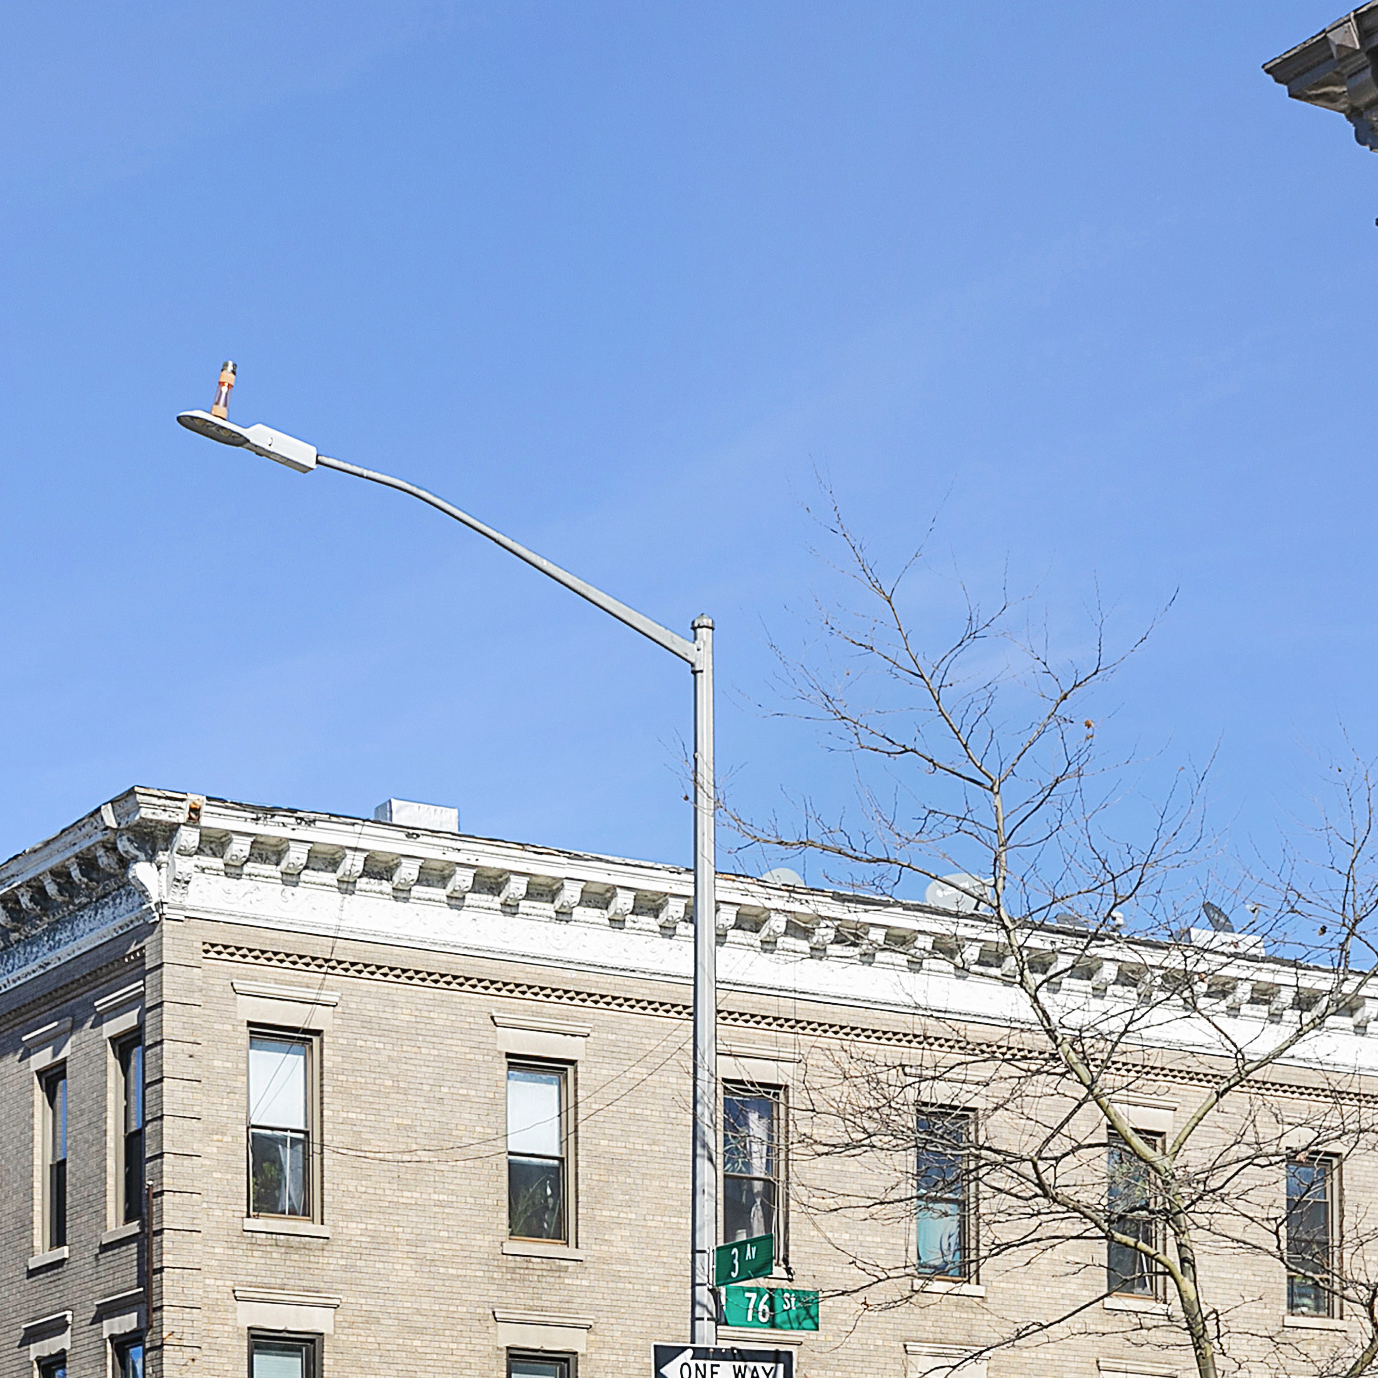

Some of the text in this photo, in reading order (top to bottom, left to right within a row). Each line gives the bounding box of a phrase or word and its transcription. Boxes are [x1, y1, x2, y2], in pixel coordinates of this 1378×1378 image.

[730, 1243, 756, 1278] 3 Av
[744, 1292, 796, 1323] 76 St
